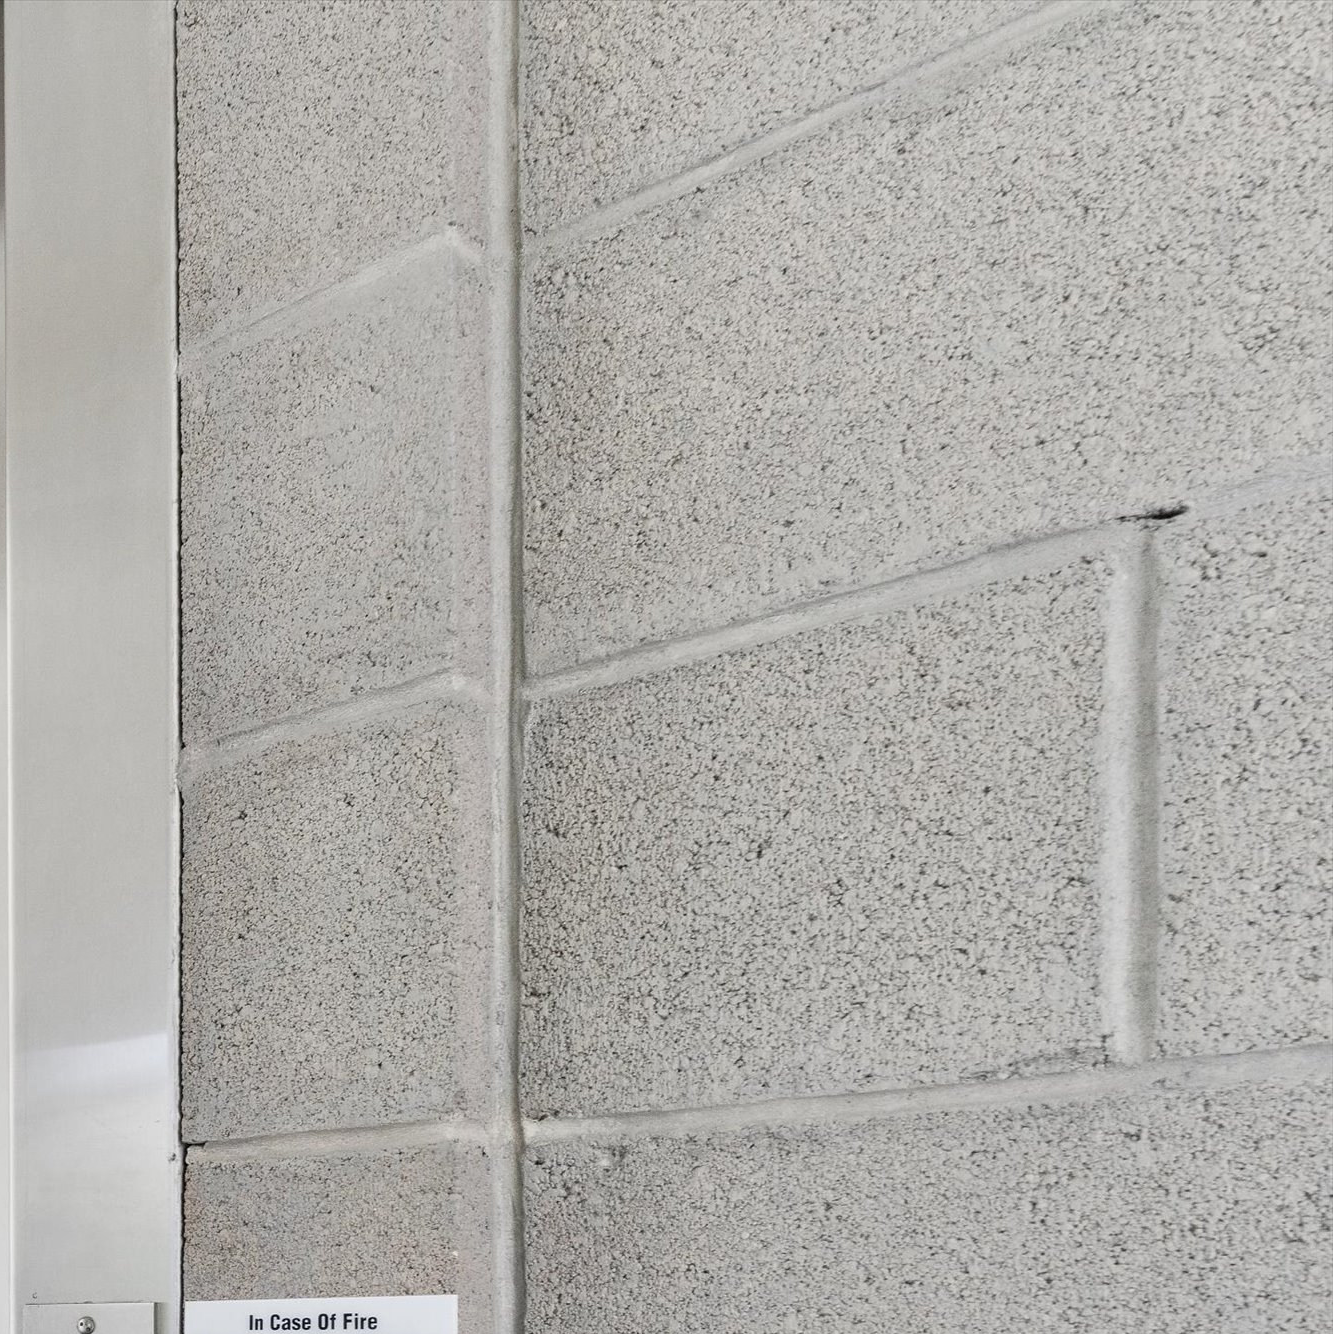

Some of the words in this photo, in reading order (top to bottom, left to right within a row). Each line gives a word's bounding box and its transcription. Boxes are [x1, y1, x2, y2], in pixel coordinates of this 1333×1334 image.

[249, 1315, 263, 1330] In
[270, 1314, 311, 1330] Case
[318, 1313, 336, 1330] Of
[343, 1313, 378, 1330] Fire
